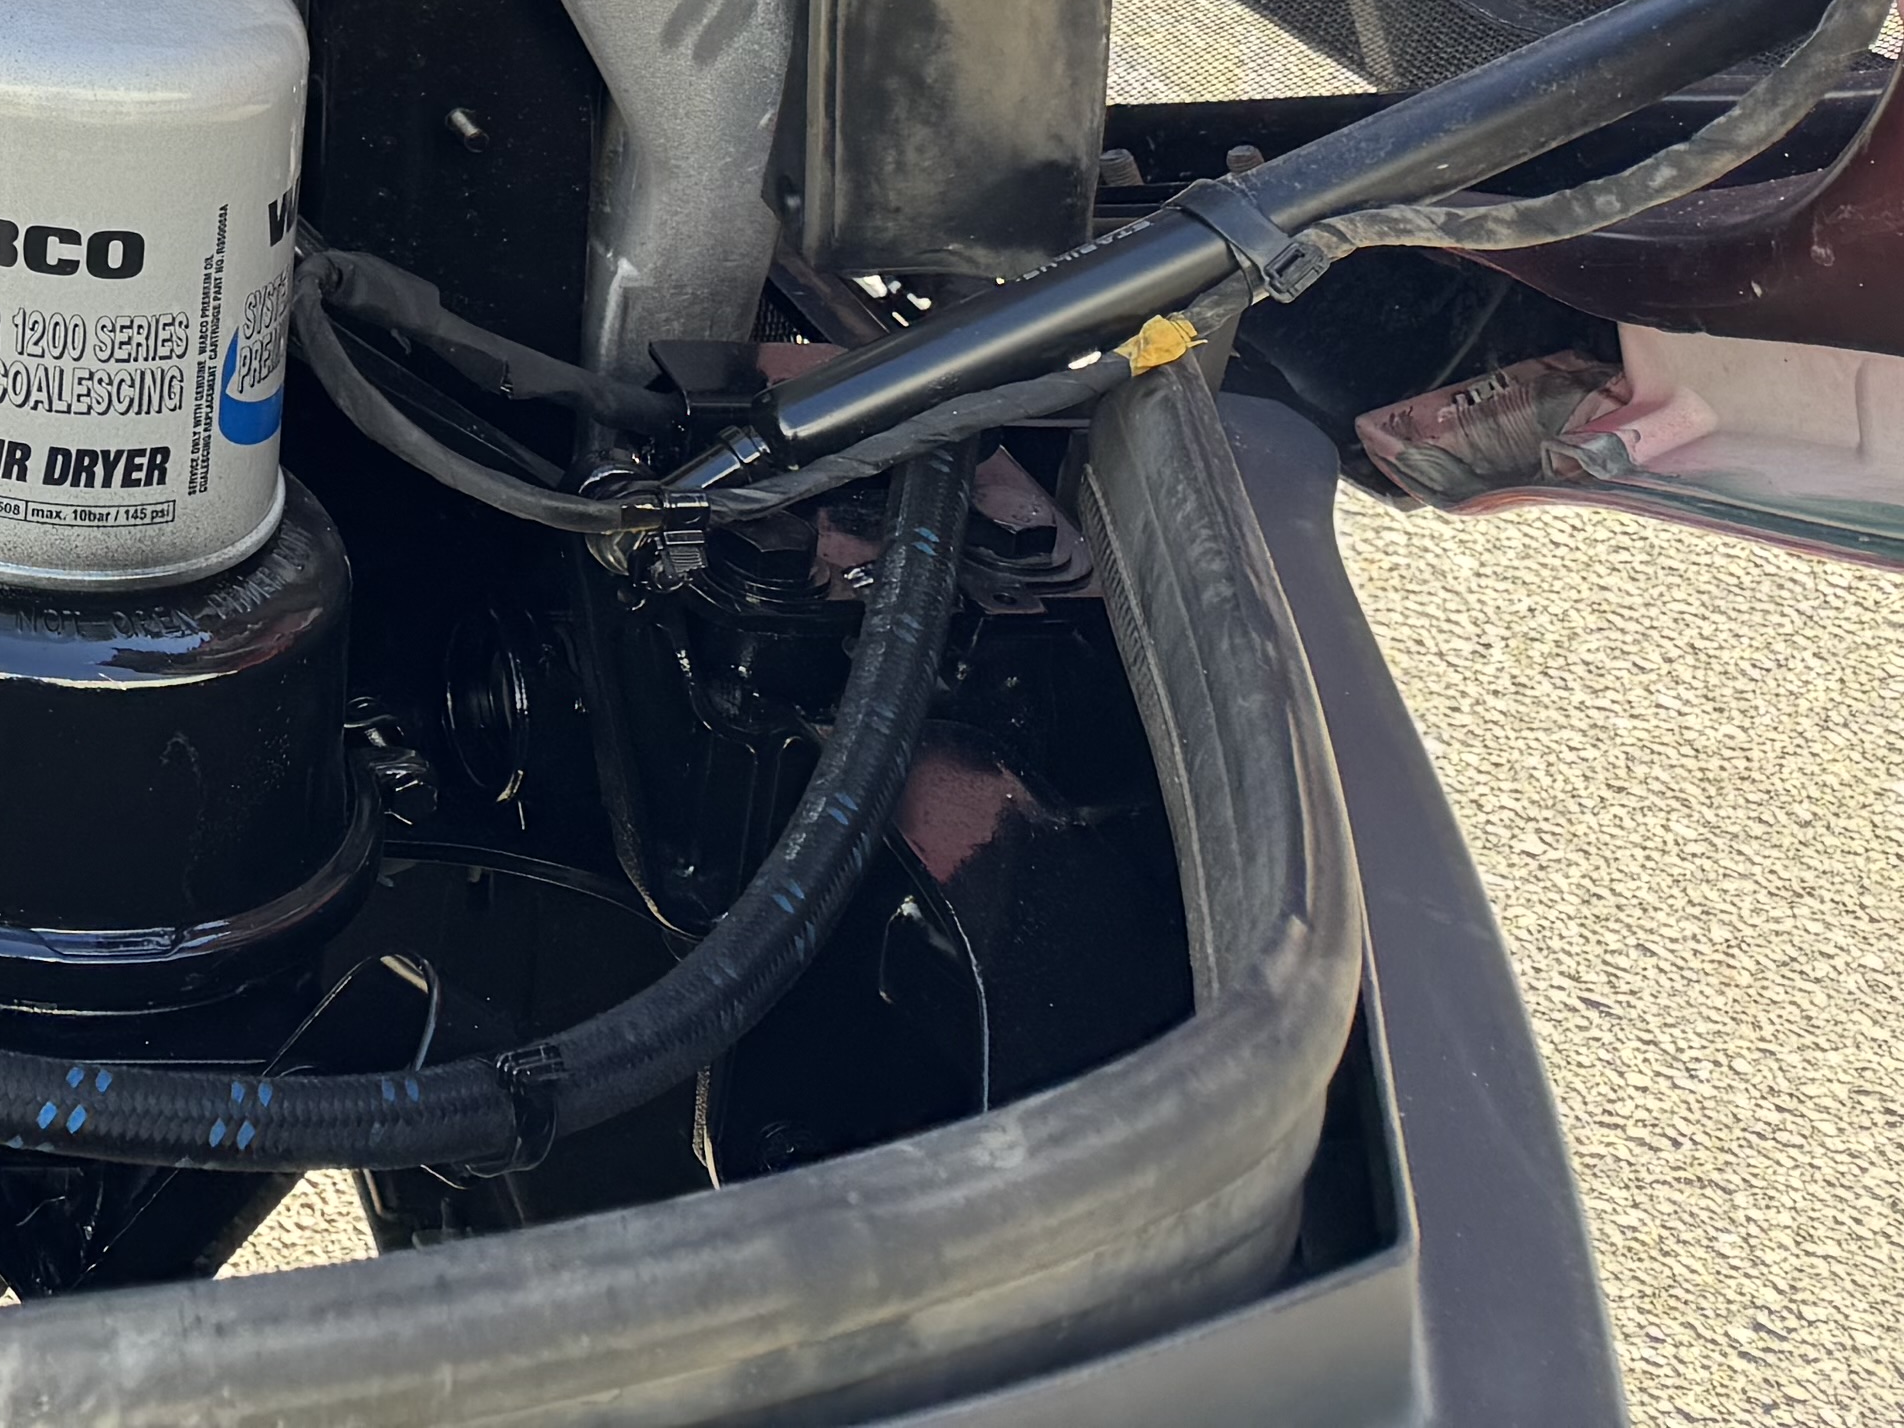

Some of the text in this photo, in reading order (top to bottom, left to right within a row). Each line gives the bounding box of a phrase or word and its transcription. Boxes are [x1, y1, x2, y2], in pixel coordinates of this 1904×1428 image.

[205, 254, 214, 271] OIL
[214, 254, 224, 273] NO.
[202, 272, 213, 318] PREMIUM
[212, 276, 223, 302] PART
[12, 307, 86, 363] 1200
[93, 311, 189, 365] SERIES
[199, 320, 209, 356] WABCO
[208, 303, 221, 360] CARTRIDGE
[195, 360, 206, 401] GENUINE
[202, 365, 216, 432] REPLACEMENT
[193, 403, 203, 429] WITH
[191, 430, 201, 455] ONLY
[42, 445, 171, 490] DRYER
[30, 505, 68, 522] max.
[71, 506, 112, 524] 10bar
[123, 506, 148, 523] 145
[149, 503, 171, 524] psi
